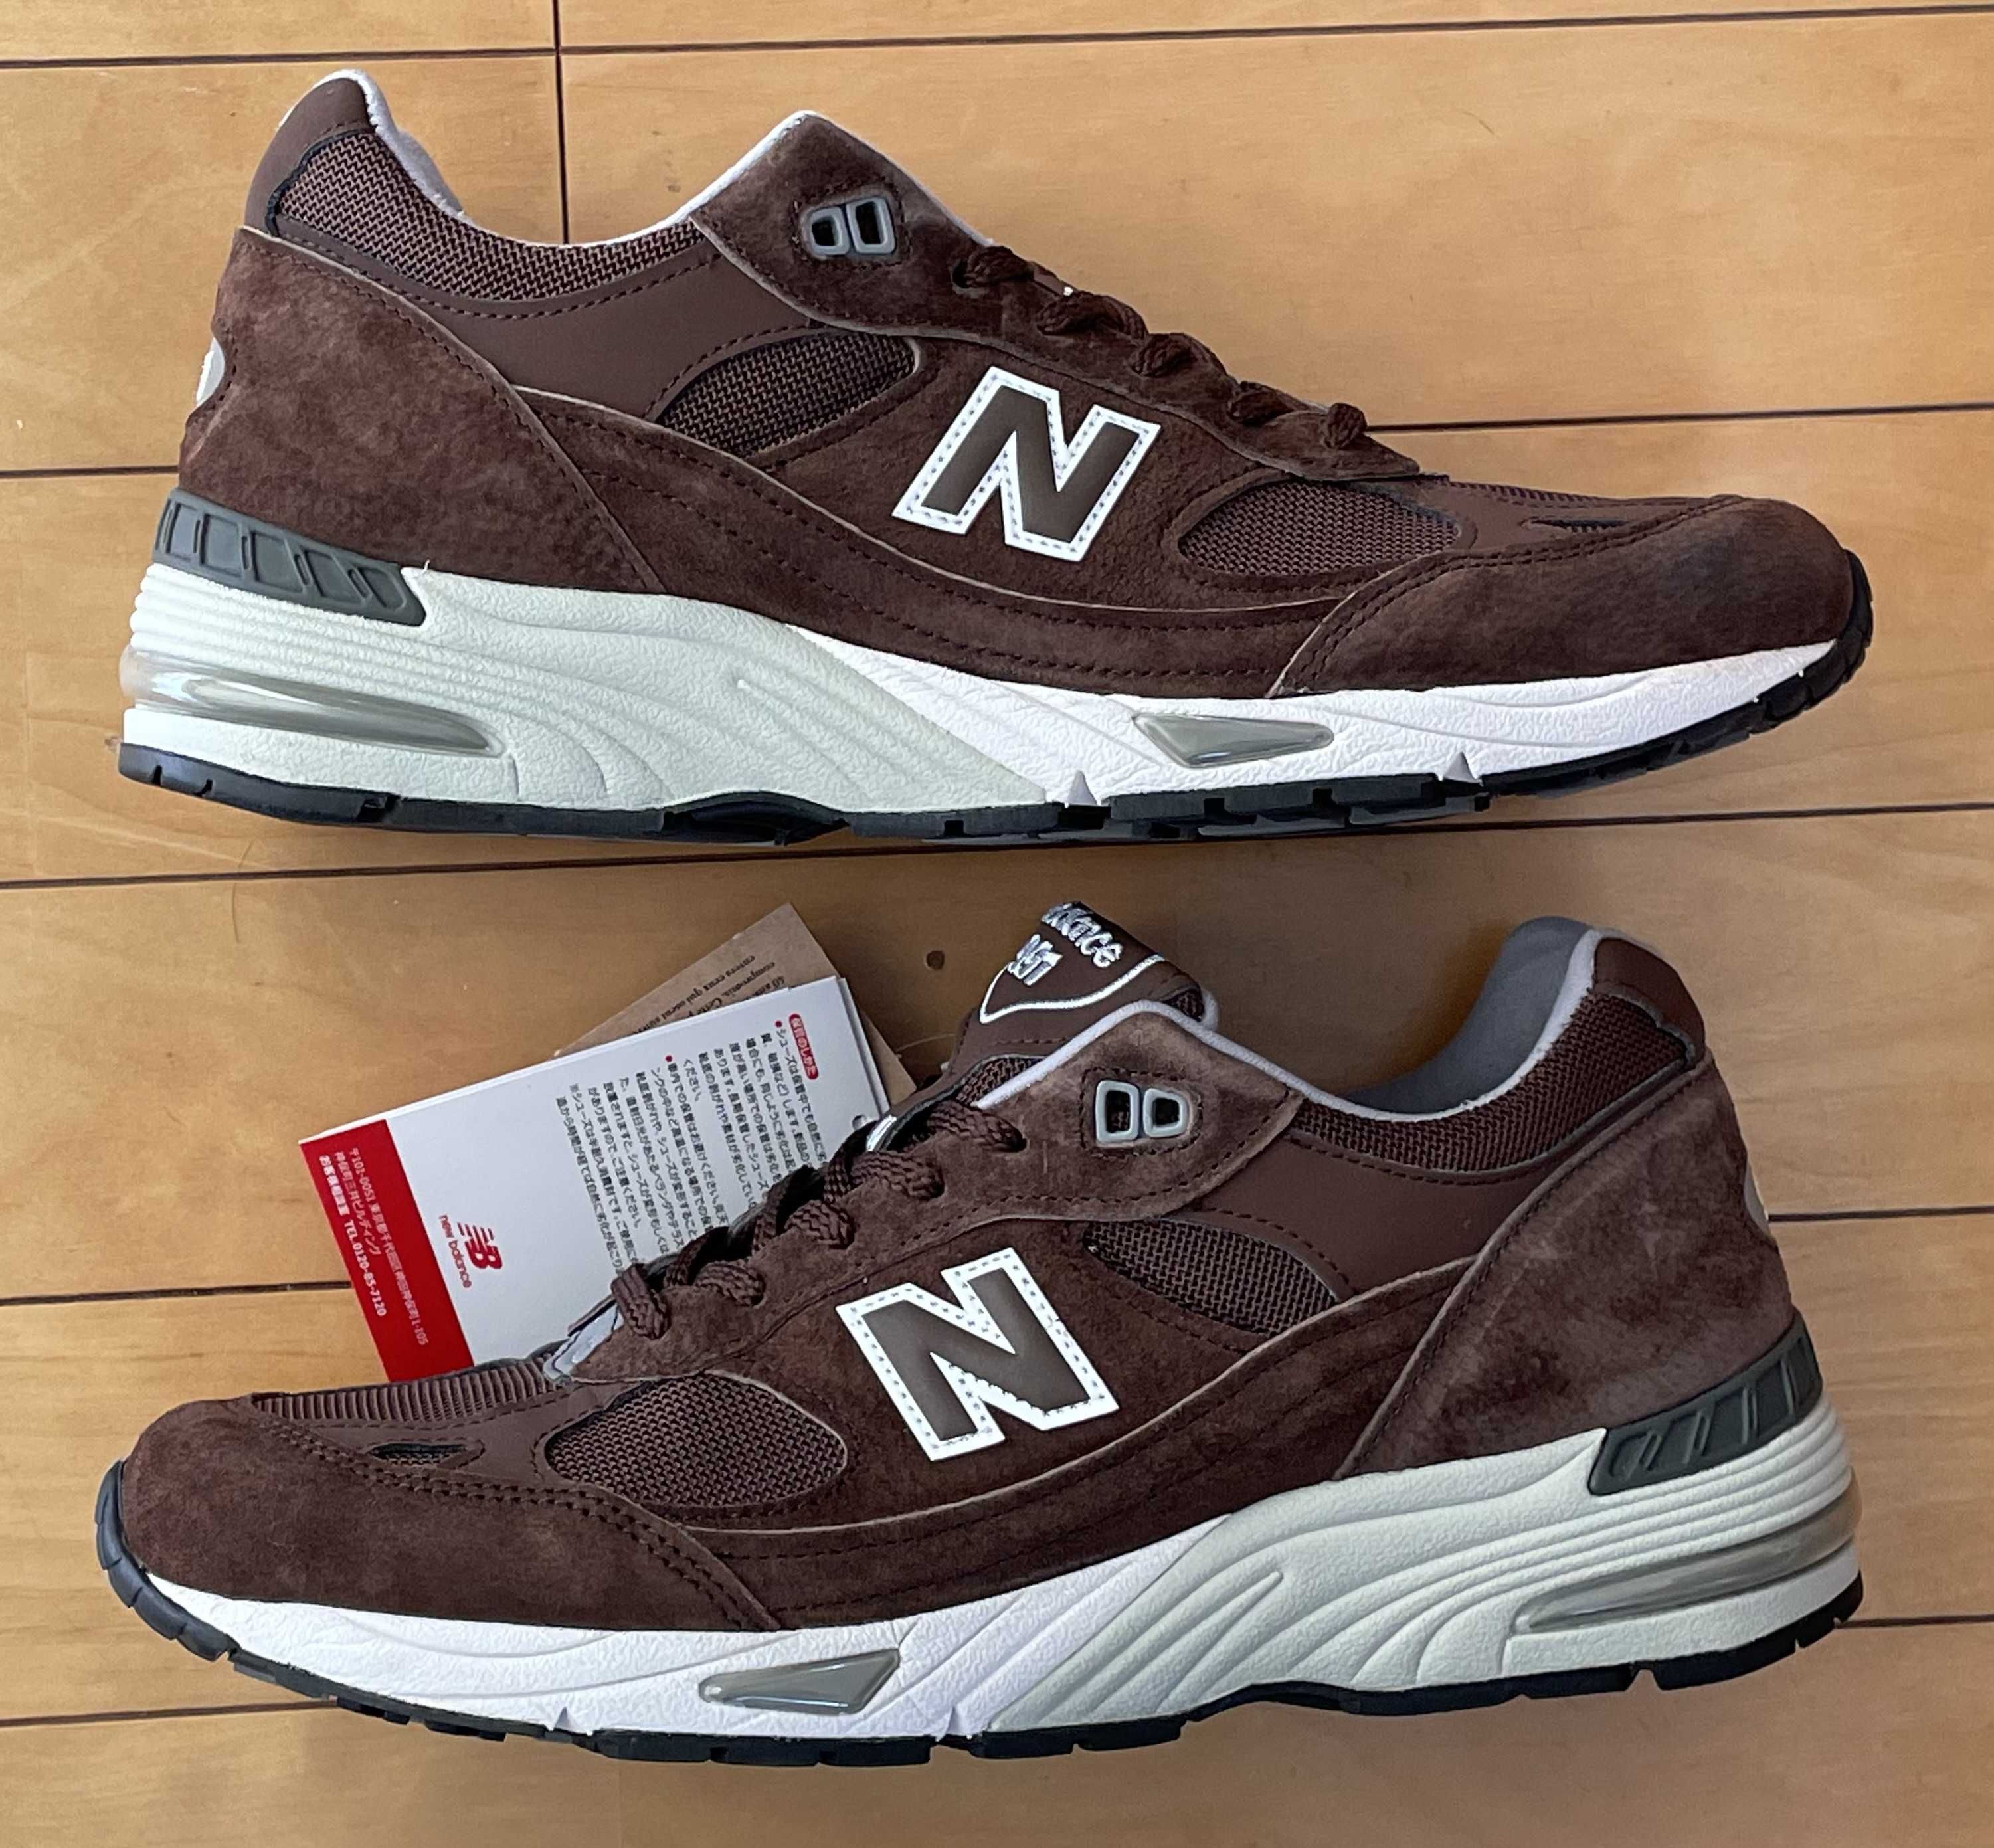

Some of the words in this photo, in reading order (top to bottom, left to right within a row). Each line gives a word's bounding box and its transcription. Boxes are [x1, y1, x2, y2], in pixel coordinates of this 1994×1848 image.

[891, 366, 1160, 561] N
[683, 986, 705, 1006] qui
[438, 1214, 454, 1240] new
[447, 1238, 474, 1289] balance
[836, 1247, 1119, 1461] N
